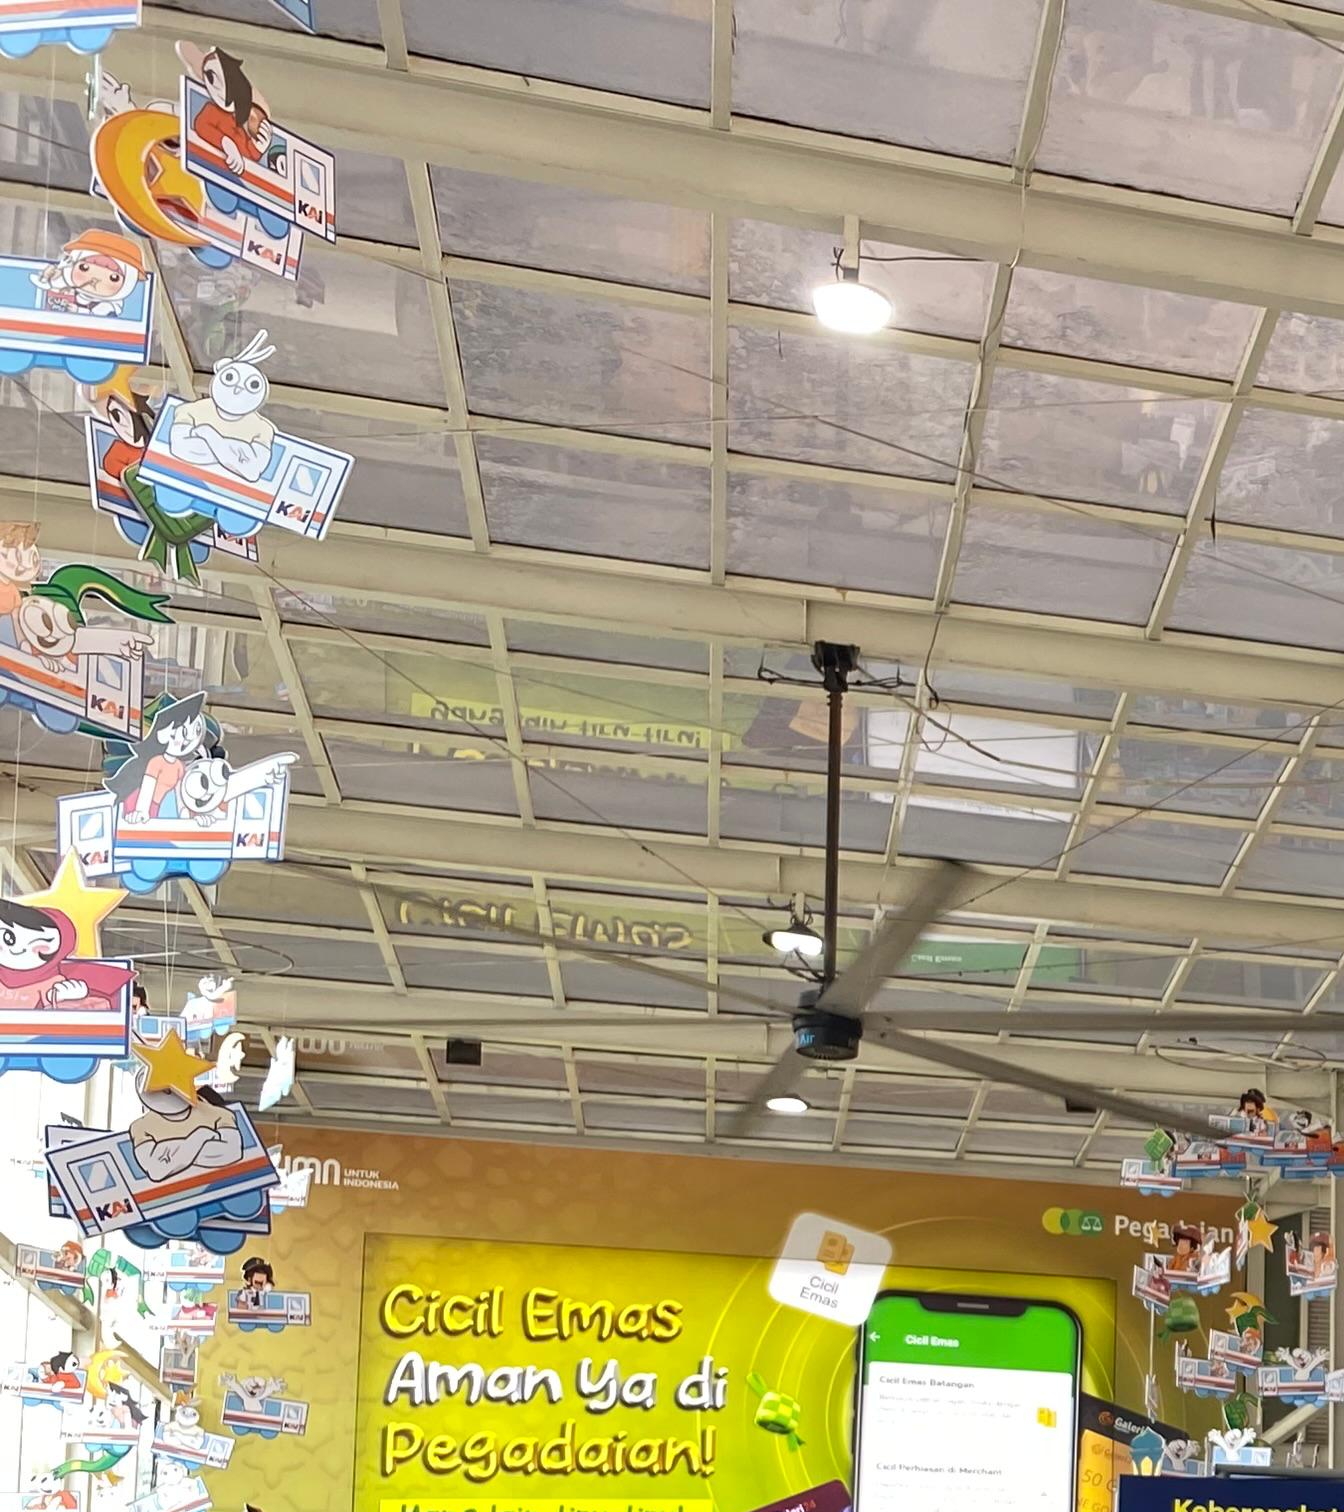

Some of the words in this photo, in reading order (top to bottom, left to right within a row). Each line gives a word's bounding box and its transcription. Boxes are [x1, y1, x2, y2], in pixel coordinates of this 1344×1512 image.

[344, 1168, 380, 1180] UNTUK
[344, 1178, 400, 1191] INDONESIA
[809, 1275, 840, 1296] Cicil
[800, 1286, 839, 1309] Emas
[383, 1283, 505, 1337] Cicil
[524, 1286, 684, 1342] Emas
[905, 1334, 929, 1346] Cicil
[930, 1335, 960, 1348] Emas
[385, 1350, 564, 1407] Aman
[577, 1356, 658, 1415] Ya
[675, 1354, 730, 1411] di
[382, 1418, 718, 1484] Pegadaian!
